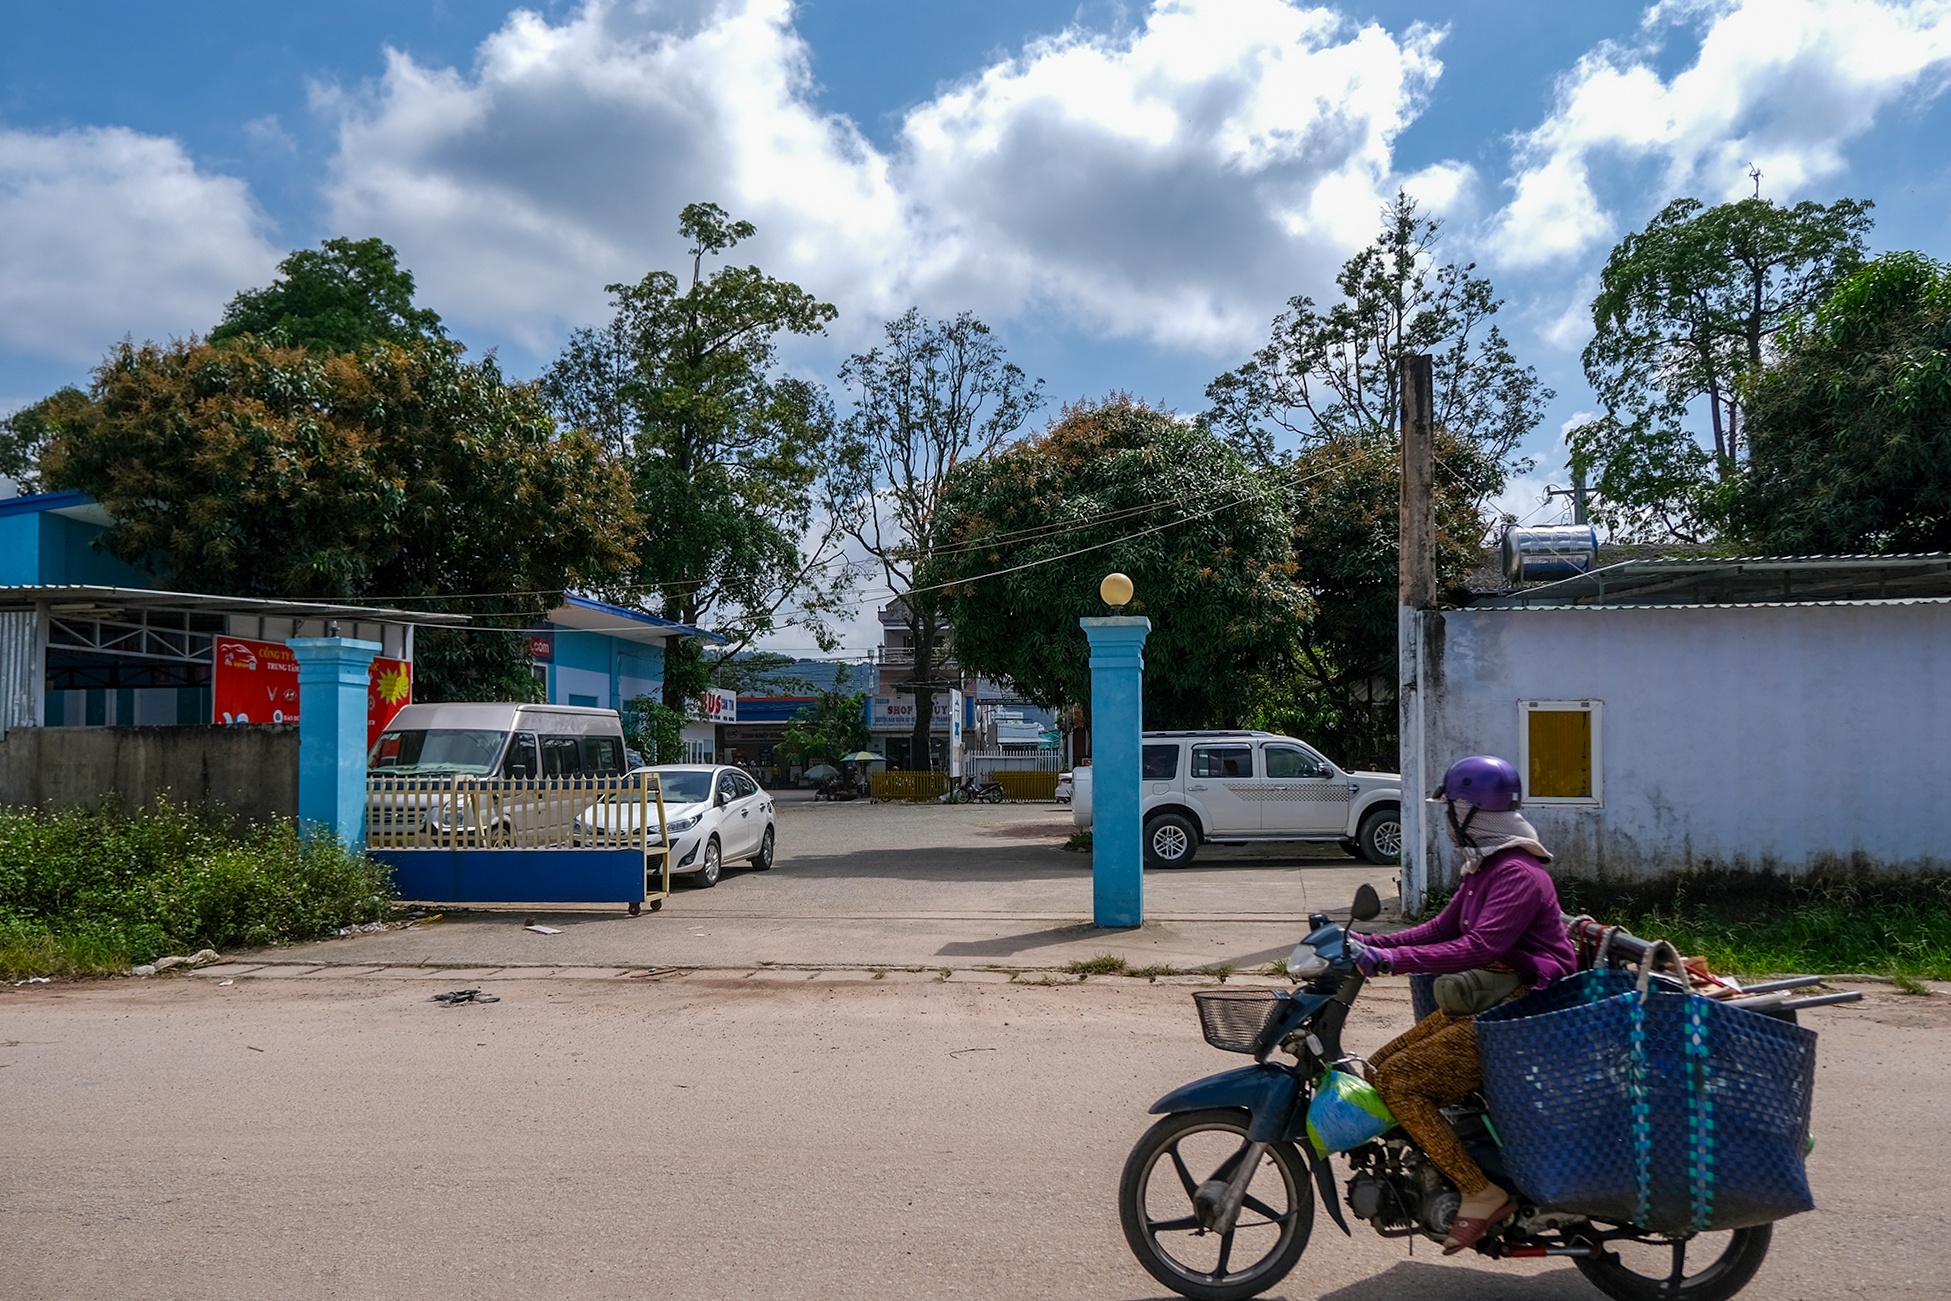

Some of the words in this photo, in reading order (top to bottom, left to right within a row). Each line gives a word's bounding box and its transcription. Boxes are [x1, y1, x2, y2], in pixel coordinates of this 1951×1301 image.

[259, 647, 280, 660] CÔNG
[281, 651, 291, 661] TY
[267, 662, 287, 672] TRUNG
[887, 705, 913, 715] SHOP
